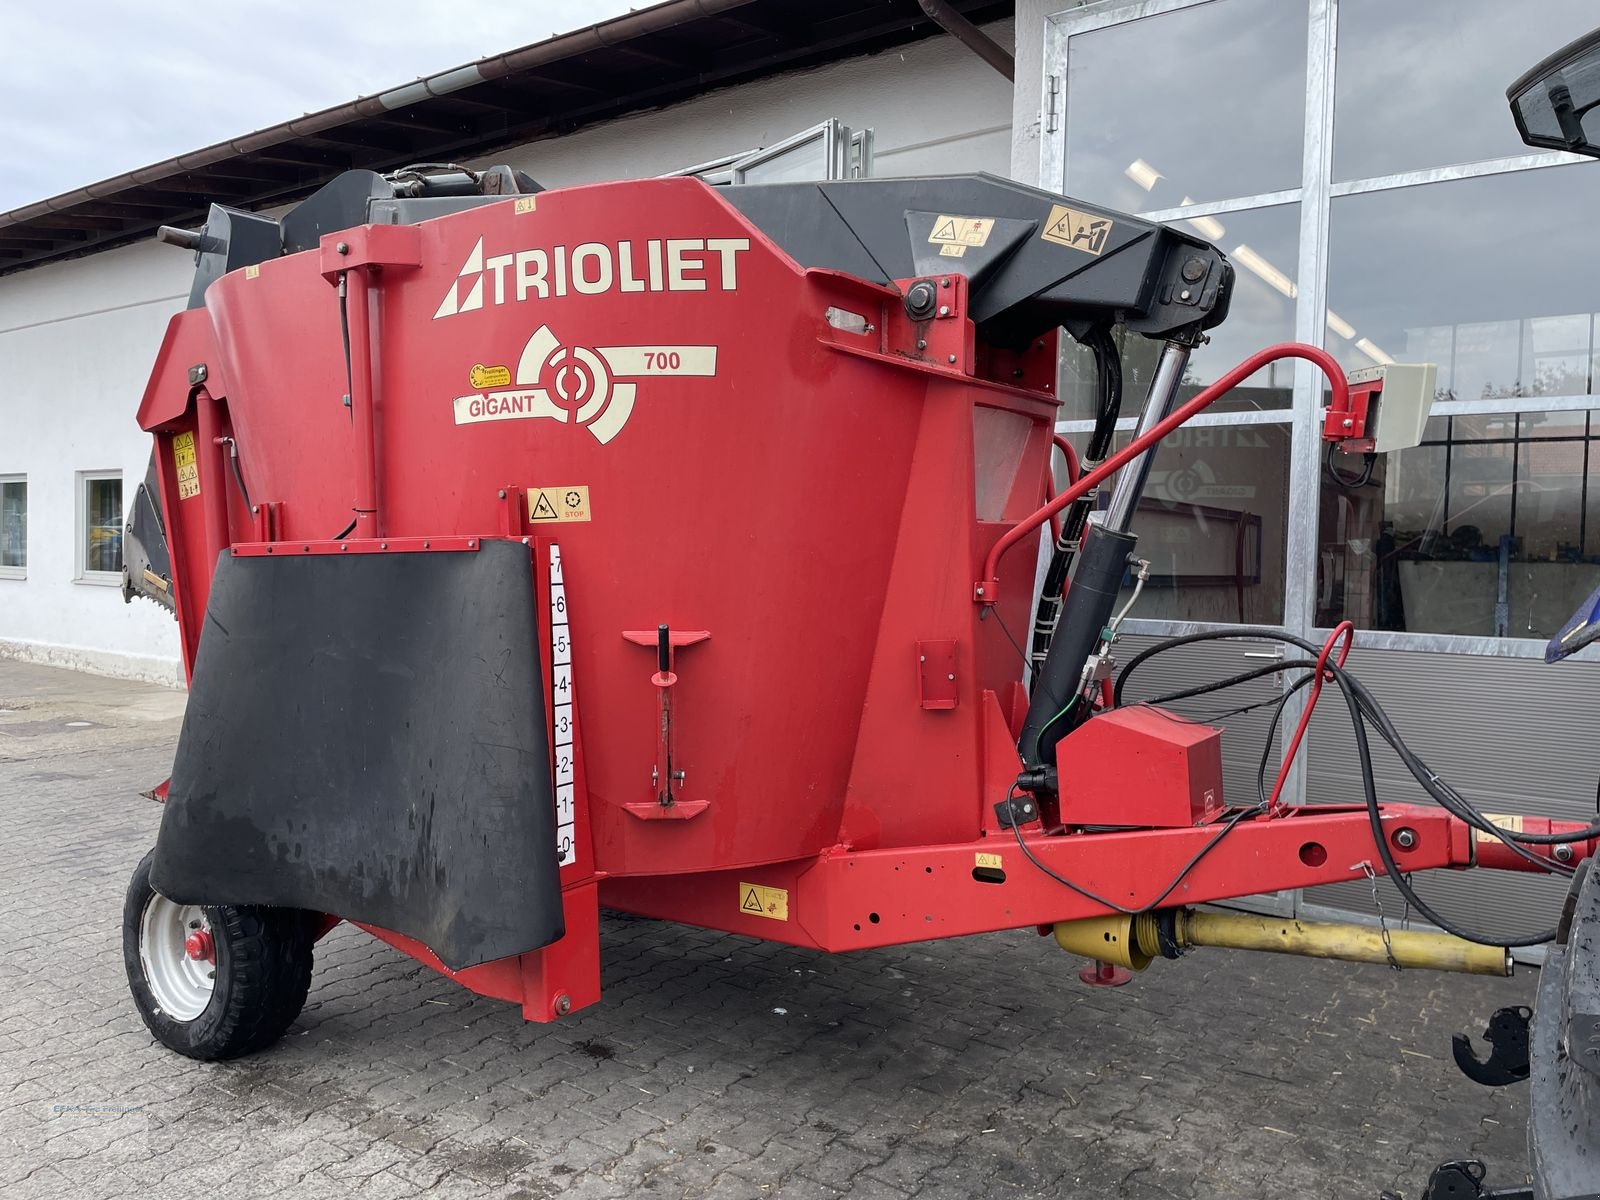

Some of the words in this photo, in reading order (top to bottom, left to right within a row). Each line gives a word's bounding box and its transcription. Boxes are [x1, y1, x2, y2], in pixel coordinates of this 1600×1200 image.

[486, 238, 751, 305] TRIOLIET
[643, 352, 681, 370] 700
[469, 395, 535, 418] GIGANT
[556, 556, 562, 573] 7
[556, 596, 565, 613] 6
[557, 635, 566, 652] 5
[559, 675, 567, 693] 4
[560, 717, 568, 734] 3
[560, 756, 569, 773] 2
[562, 796, 568, 813] 1
[562, 836, 570, 853] 0
